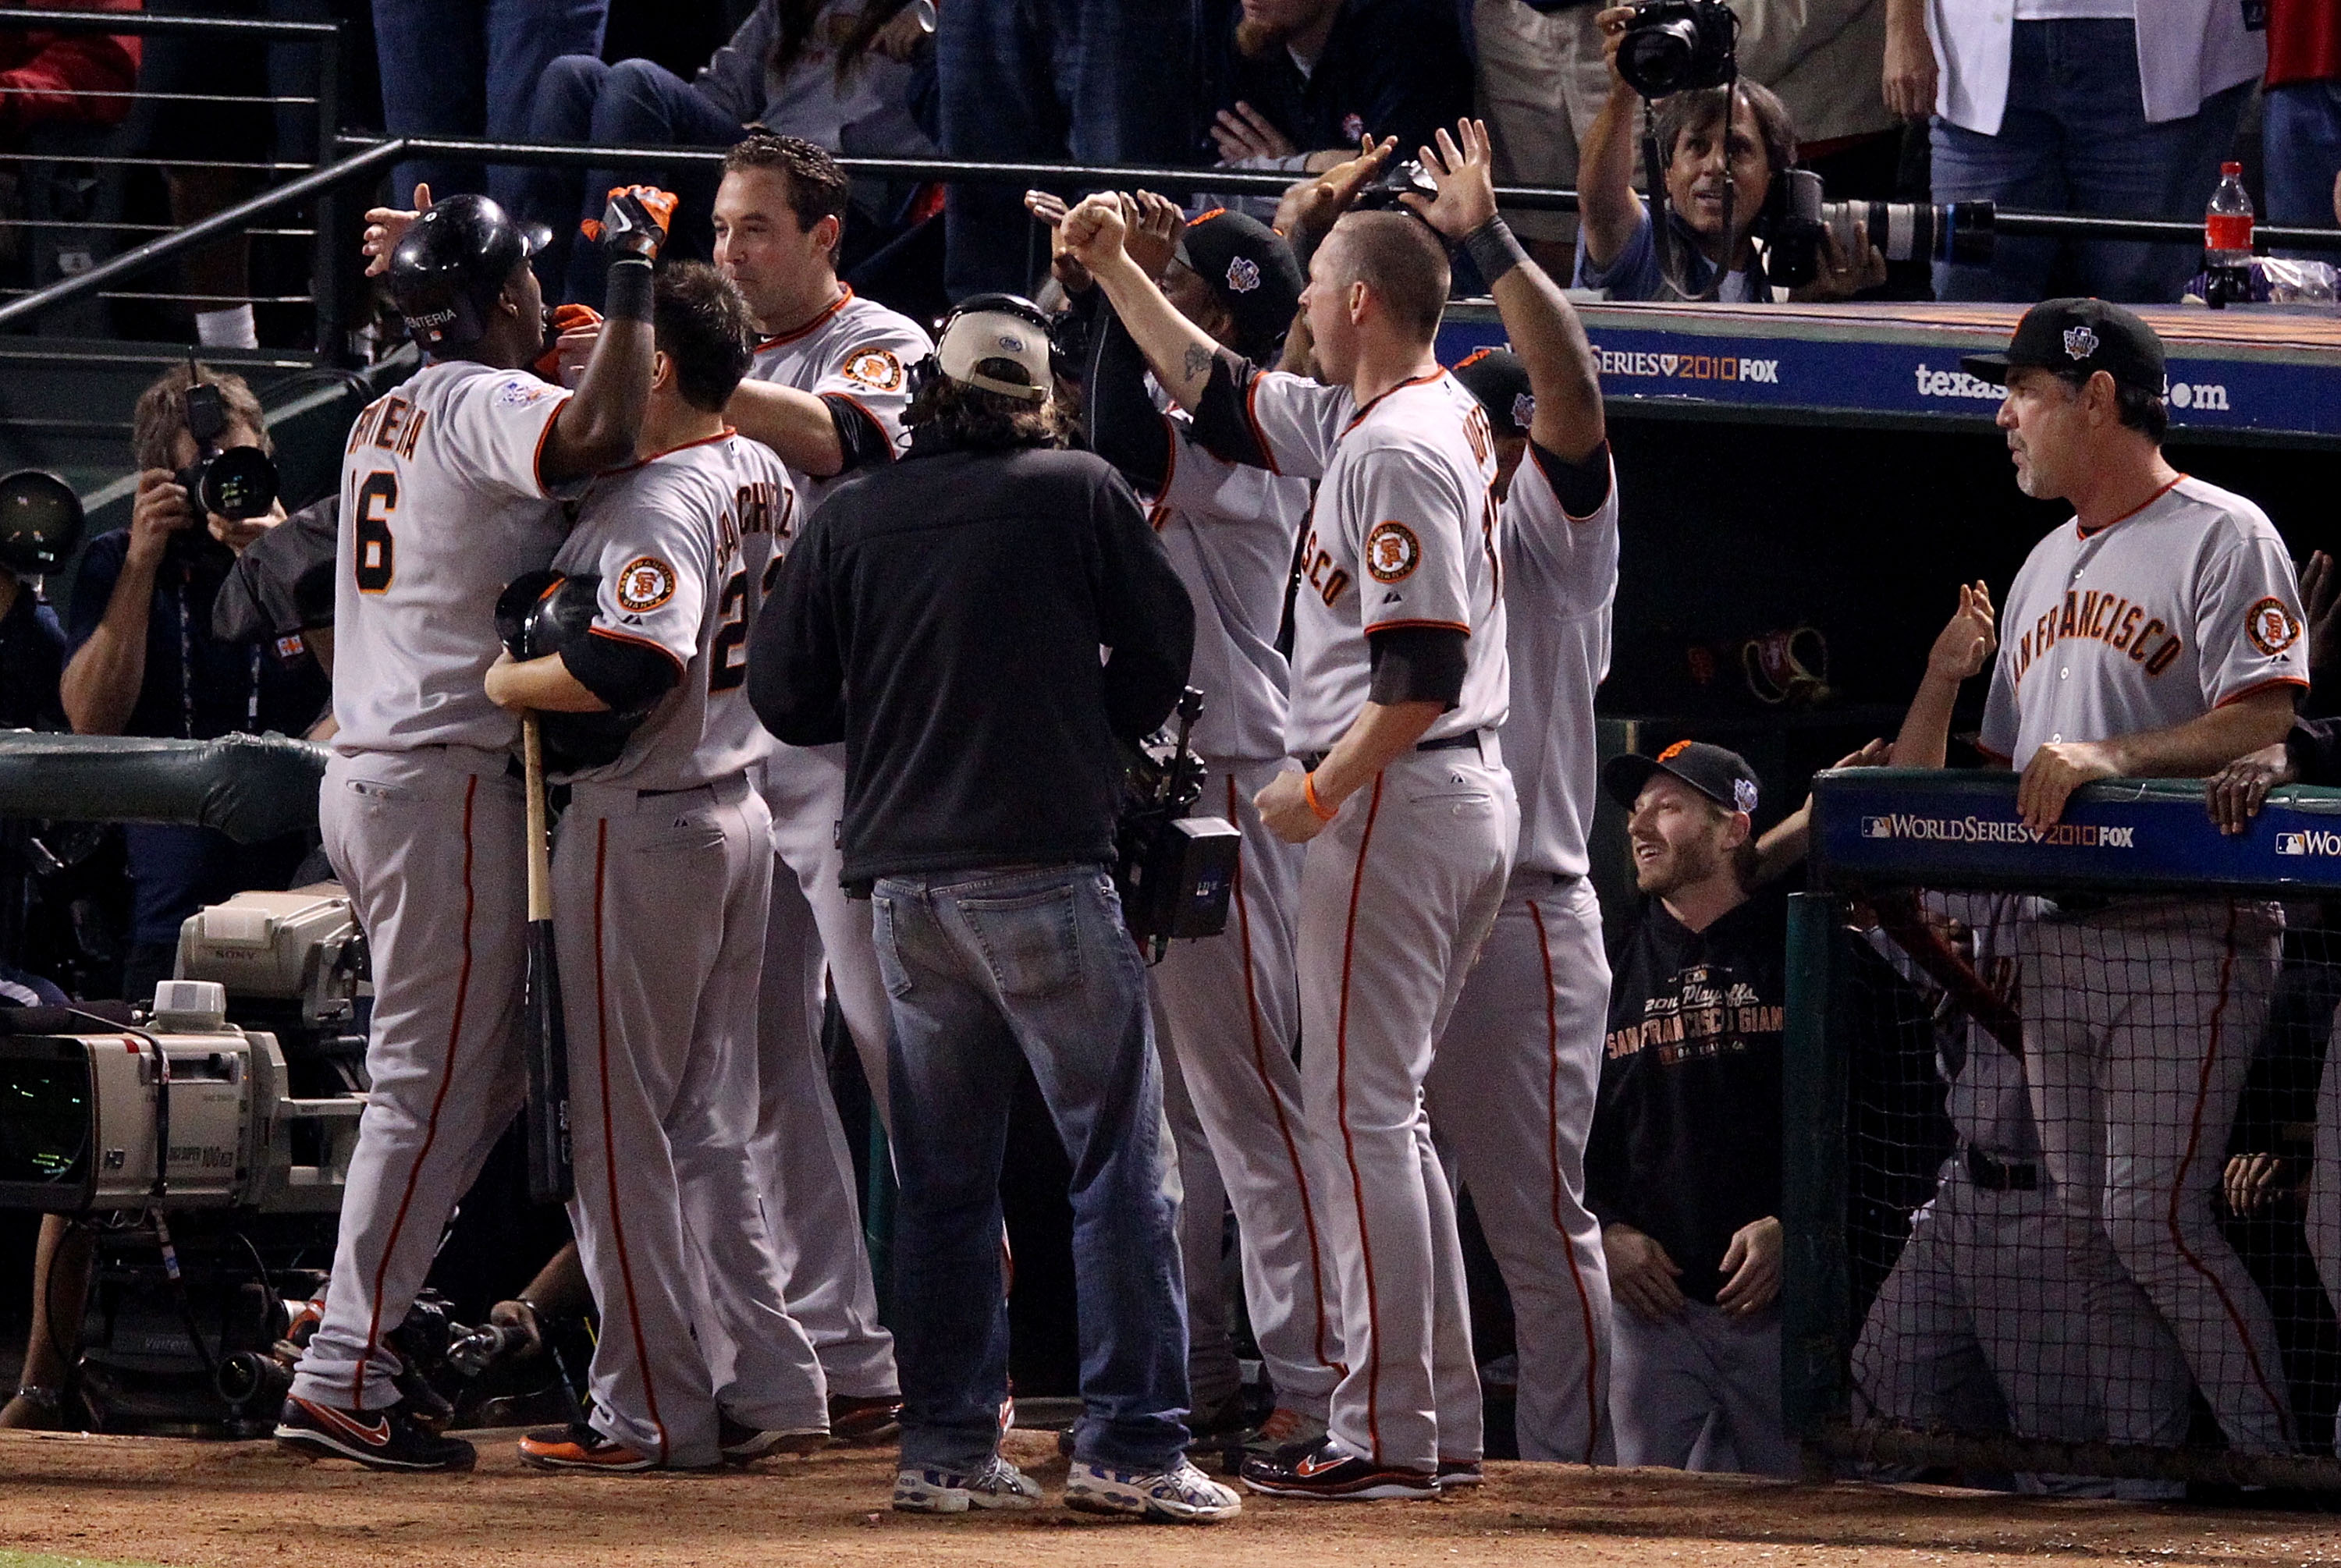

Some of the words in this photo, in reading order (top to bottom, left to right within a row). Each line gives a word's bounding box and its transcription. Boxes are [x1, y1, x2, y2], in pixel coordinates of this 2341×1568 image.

[1679, 355, 1737, 380] 2010
[1739, 358, 1778, 384] FOX
[2035, 590, 2183, 677] FRANCISCO
[2099, 826, 2134, 848] FOX
[2304, 829, 2341, 856] WO
[1606, 1026, 1639, 1060] SAN
